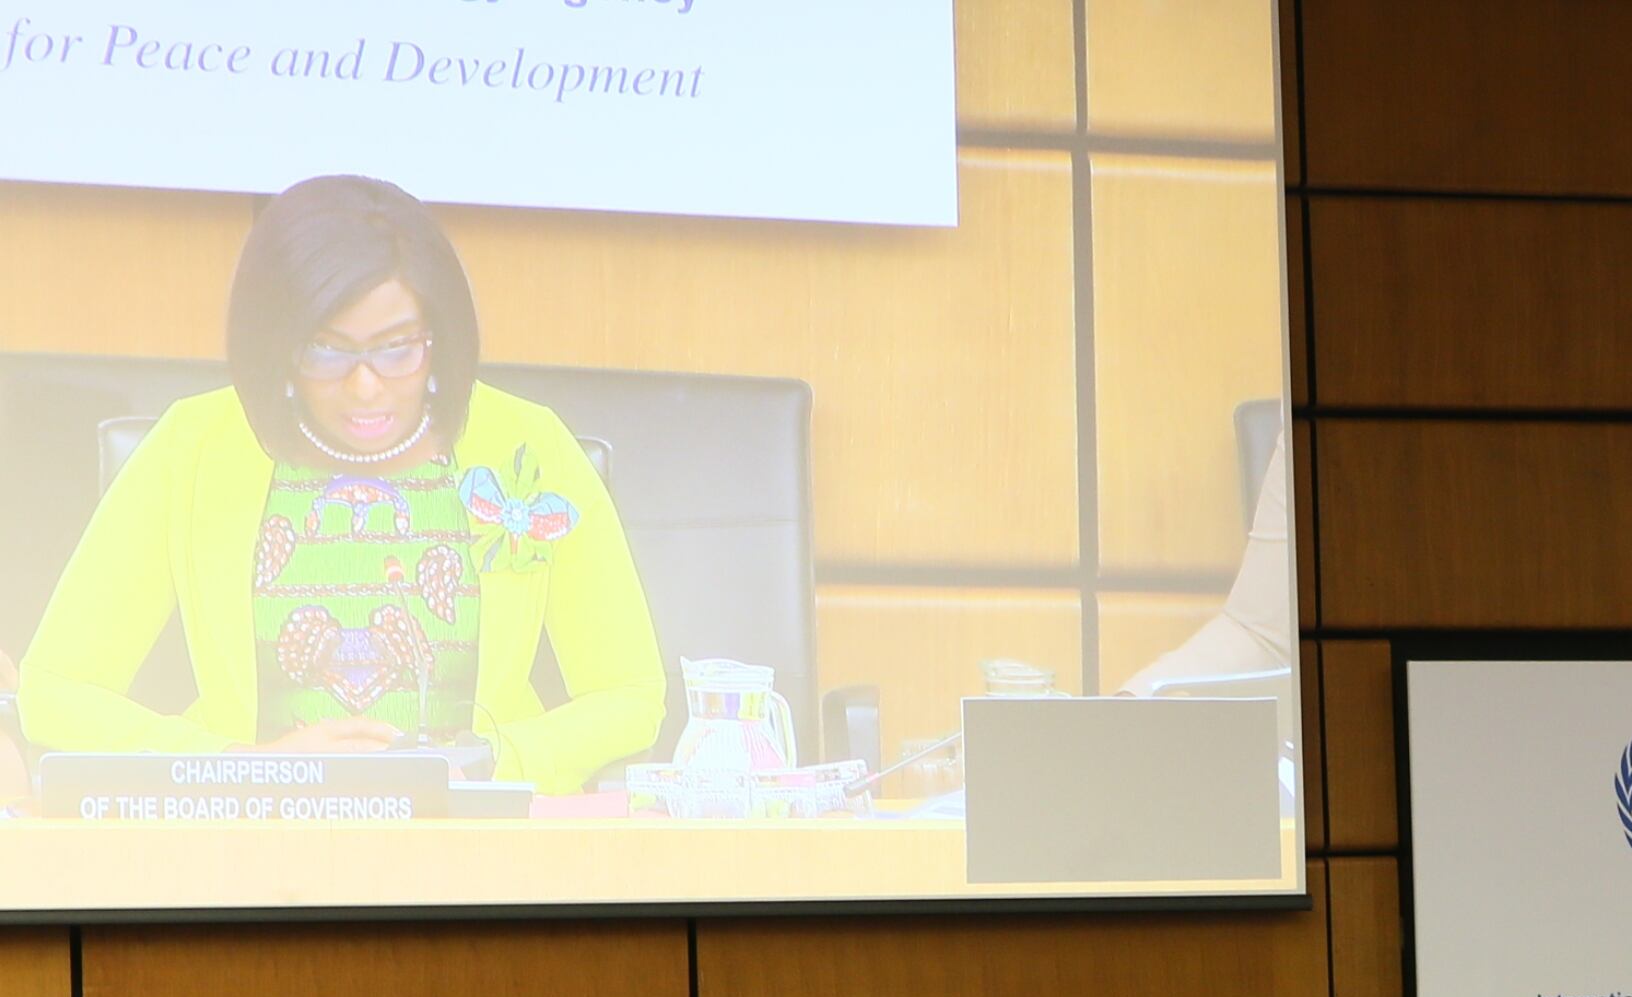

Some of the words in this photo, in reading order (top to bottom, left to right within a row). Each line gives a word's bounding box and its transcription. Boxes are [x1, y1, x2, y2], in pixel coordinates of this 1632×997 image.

[1, 16, 84, 72] for
[101, 24, 251, 74] Peace
[270, 37, 366, 80] and
[383, 41, 704, 103] Development
[171, 760, 324, 784] CHAIRPERSON
[80, 796, 110, 820] OF
[116, 796, 158, 820] THE
[164, 796, 240, 820] BOARD
[245, 796, 274, 820] OF
[280, 796, 413, 820] GOVERNORS
